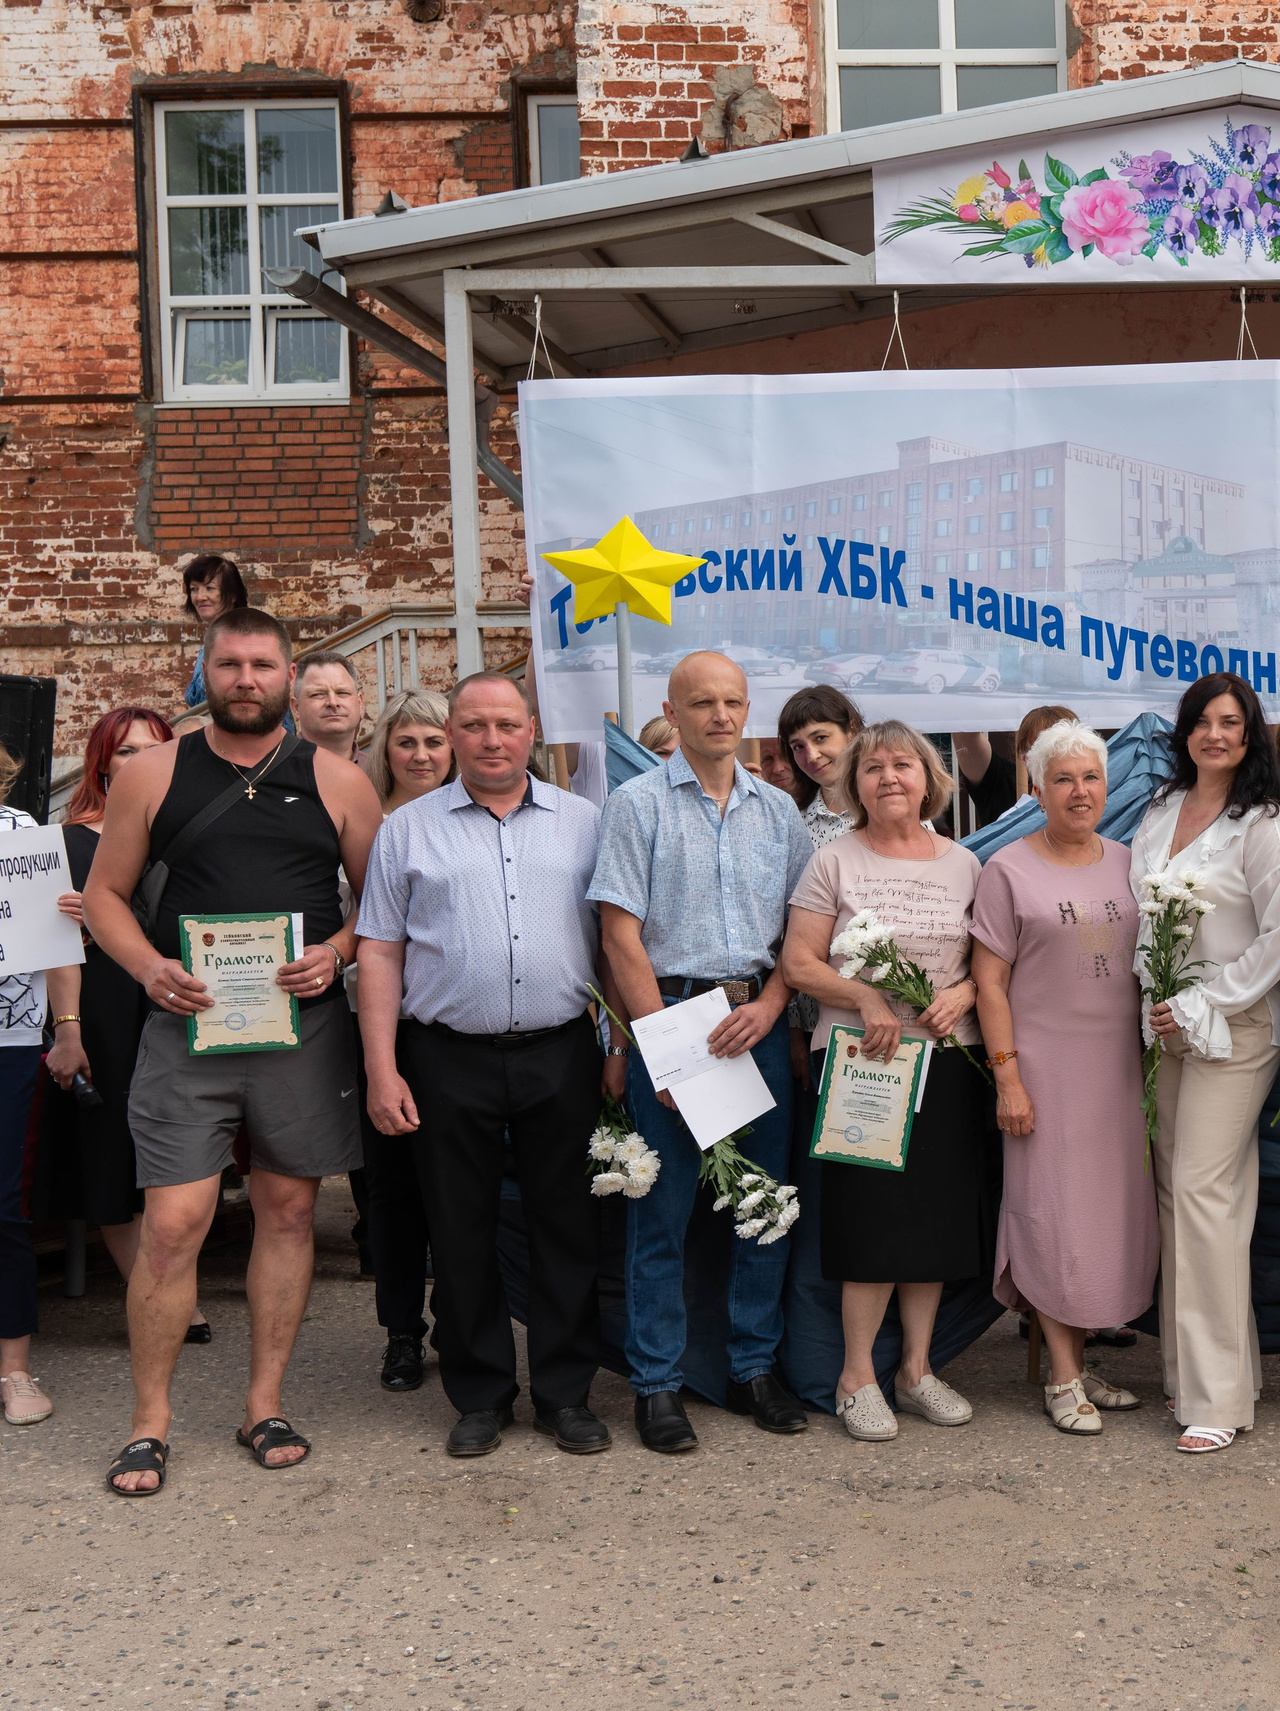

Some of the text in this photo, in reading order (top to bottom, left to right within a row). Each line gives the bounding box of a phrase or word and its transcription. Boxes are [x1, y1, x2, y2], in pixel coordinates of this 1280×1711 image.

[817, 536, 908, 608] ХБК
[949, 577, 1065, 650] наша
[0, 851, 61, 882] продукции
[203, 953, 274, 970] Грамота
[842, 1064, 901, 1085] Грамота
